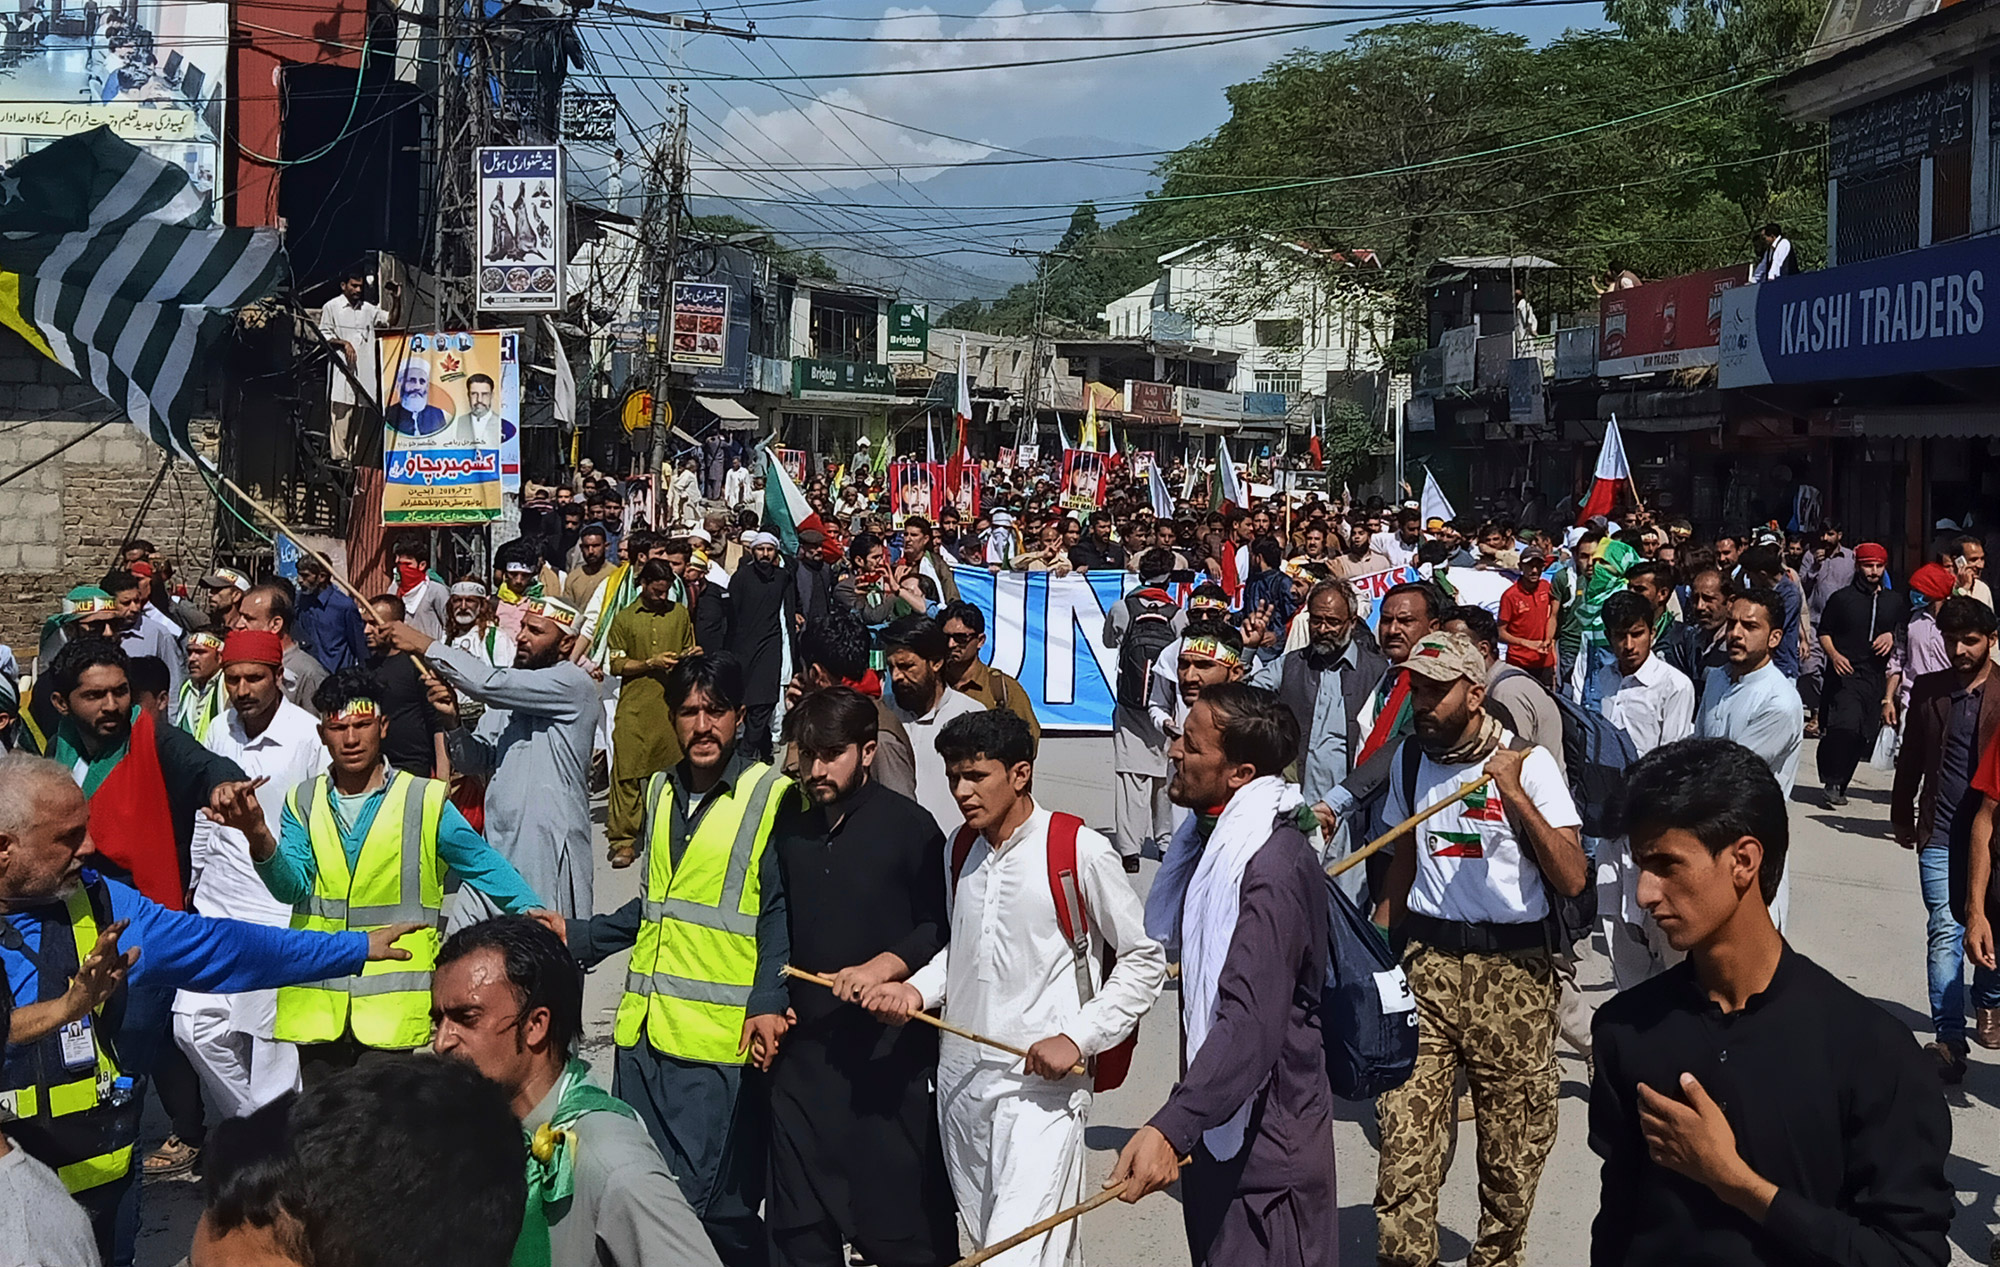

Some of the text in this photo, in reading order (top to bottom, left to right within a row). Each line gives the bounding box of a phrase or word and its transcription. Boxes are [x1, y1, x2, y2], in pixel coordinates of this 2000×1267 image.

[118, 109, 139, 132] تعلیم
[134, 119, 154, 131] جدید
[154, 113, 167, 131] کی
[164, 114, 188, 133] کمپیوٹر
[483, 151, 553, 174] نیو شنواری ہوٹل
[1780, 269, 1985, 356] KASHI TRADERS
[890, 334, 922, 346] Brighto
[811, 365, 837, 383] Brighto
[406, 452, 442, 485] بچاؤ
[441, 450, 495, 477] کشمیر
[440, 487, 455, 495] 2019
[346, 700, 373, 716] JKLF
